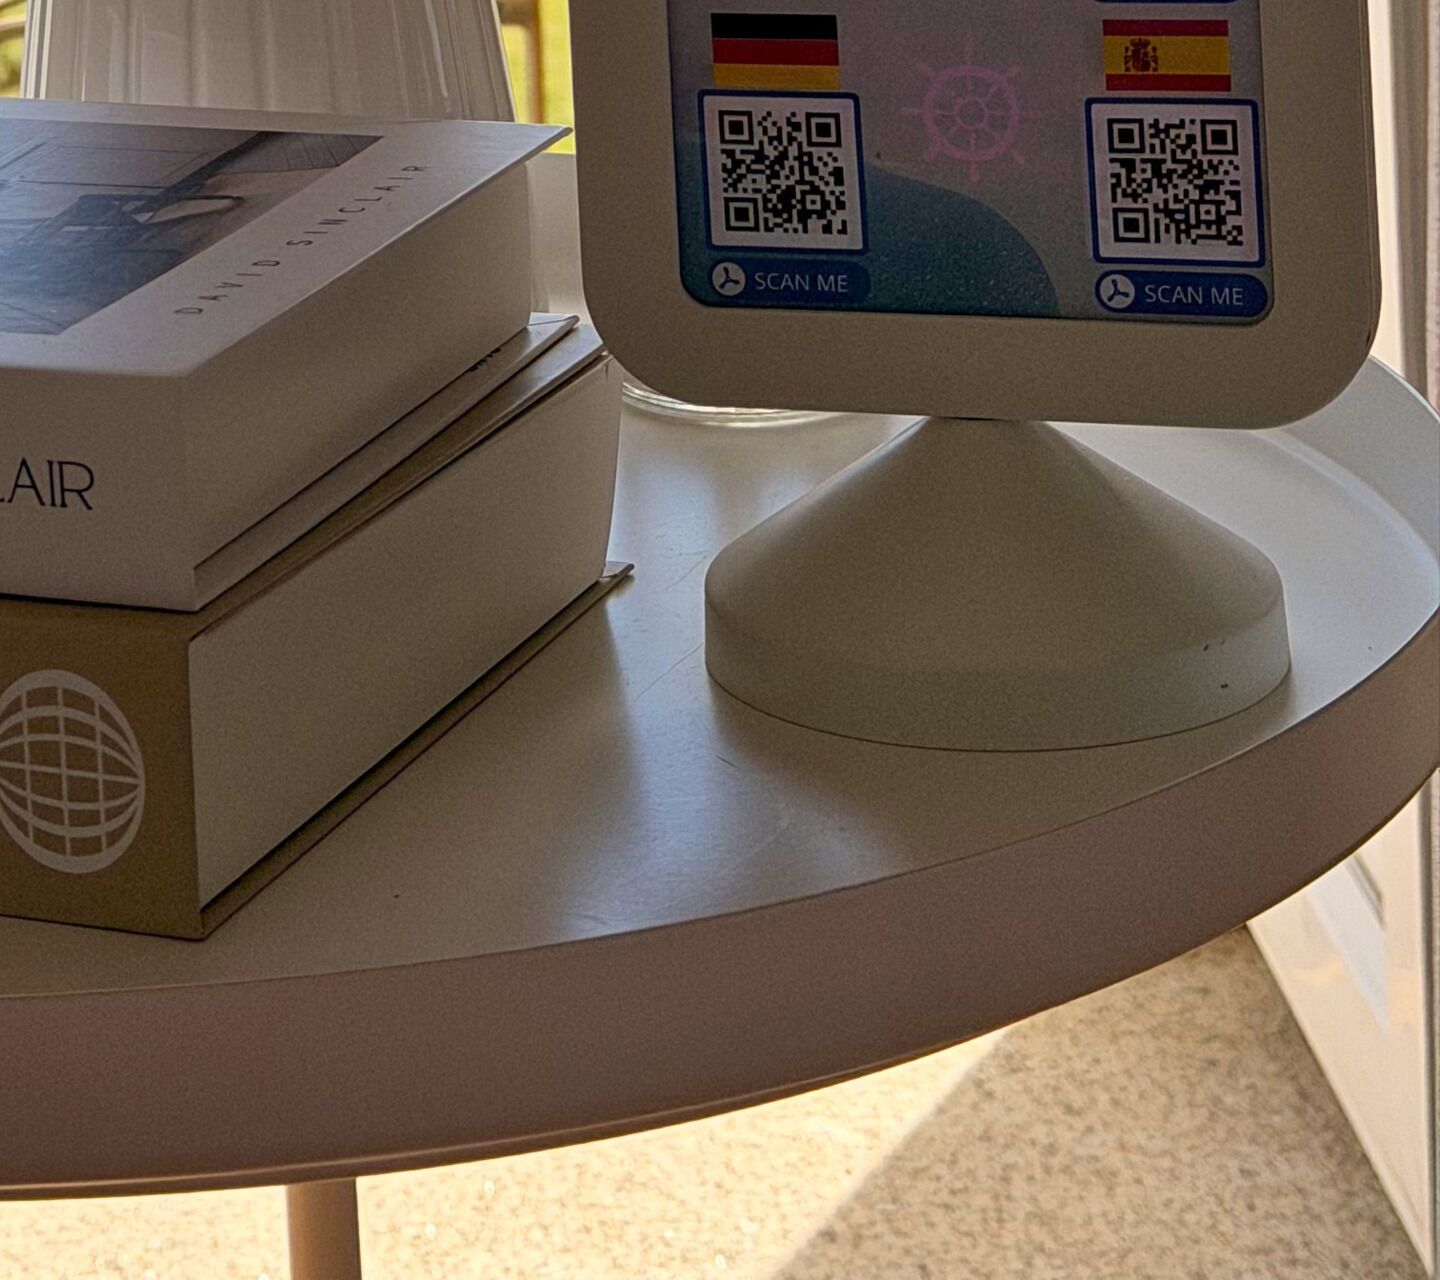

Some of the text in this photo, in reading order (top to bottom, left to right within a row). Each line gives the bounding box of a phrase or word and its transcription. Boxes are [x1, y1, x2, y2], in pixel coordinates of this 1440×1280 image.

[173, 164, 433, 316] DAVID SINCLAIR
[754, 272, 849, 293] SCAN ME
[1144, 284, 1244, 306] SCAN ME
